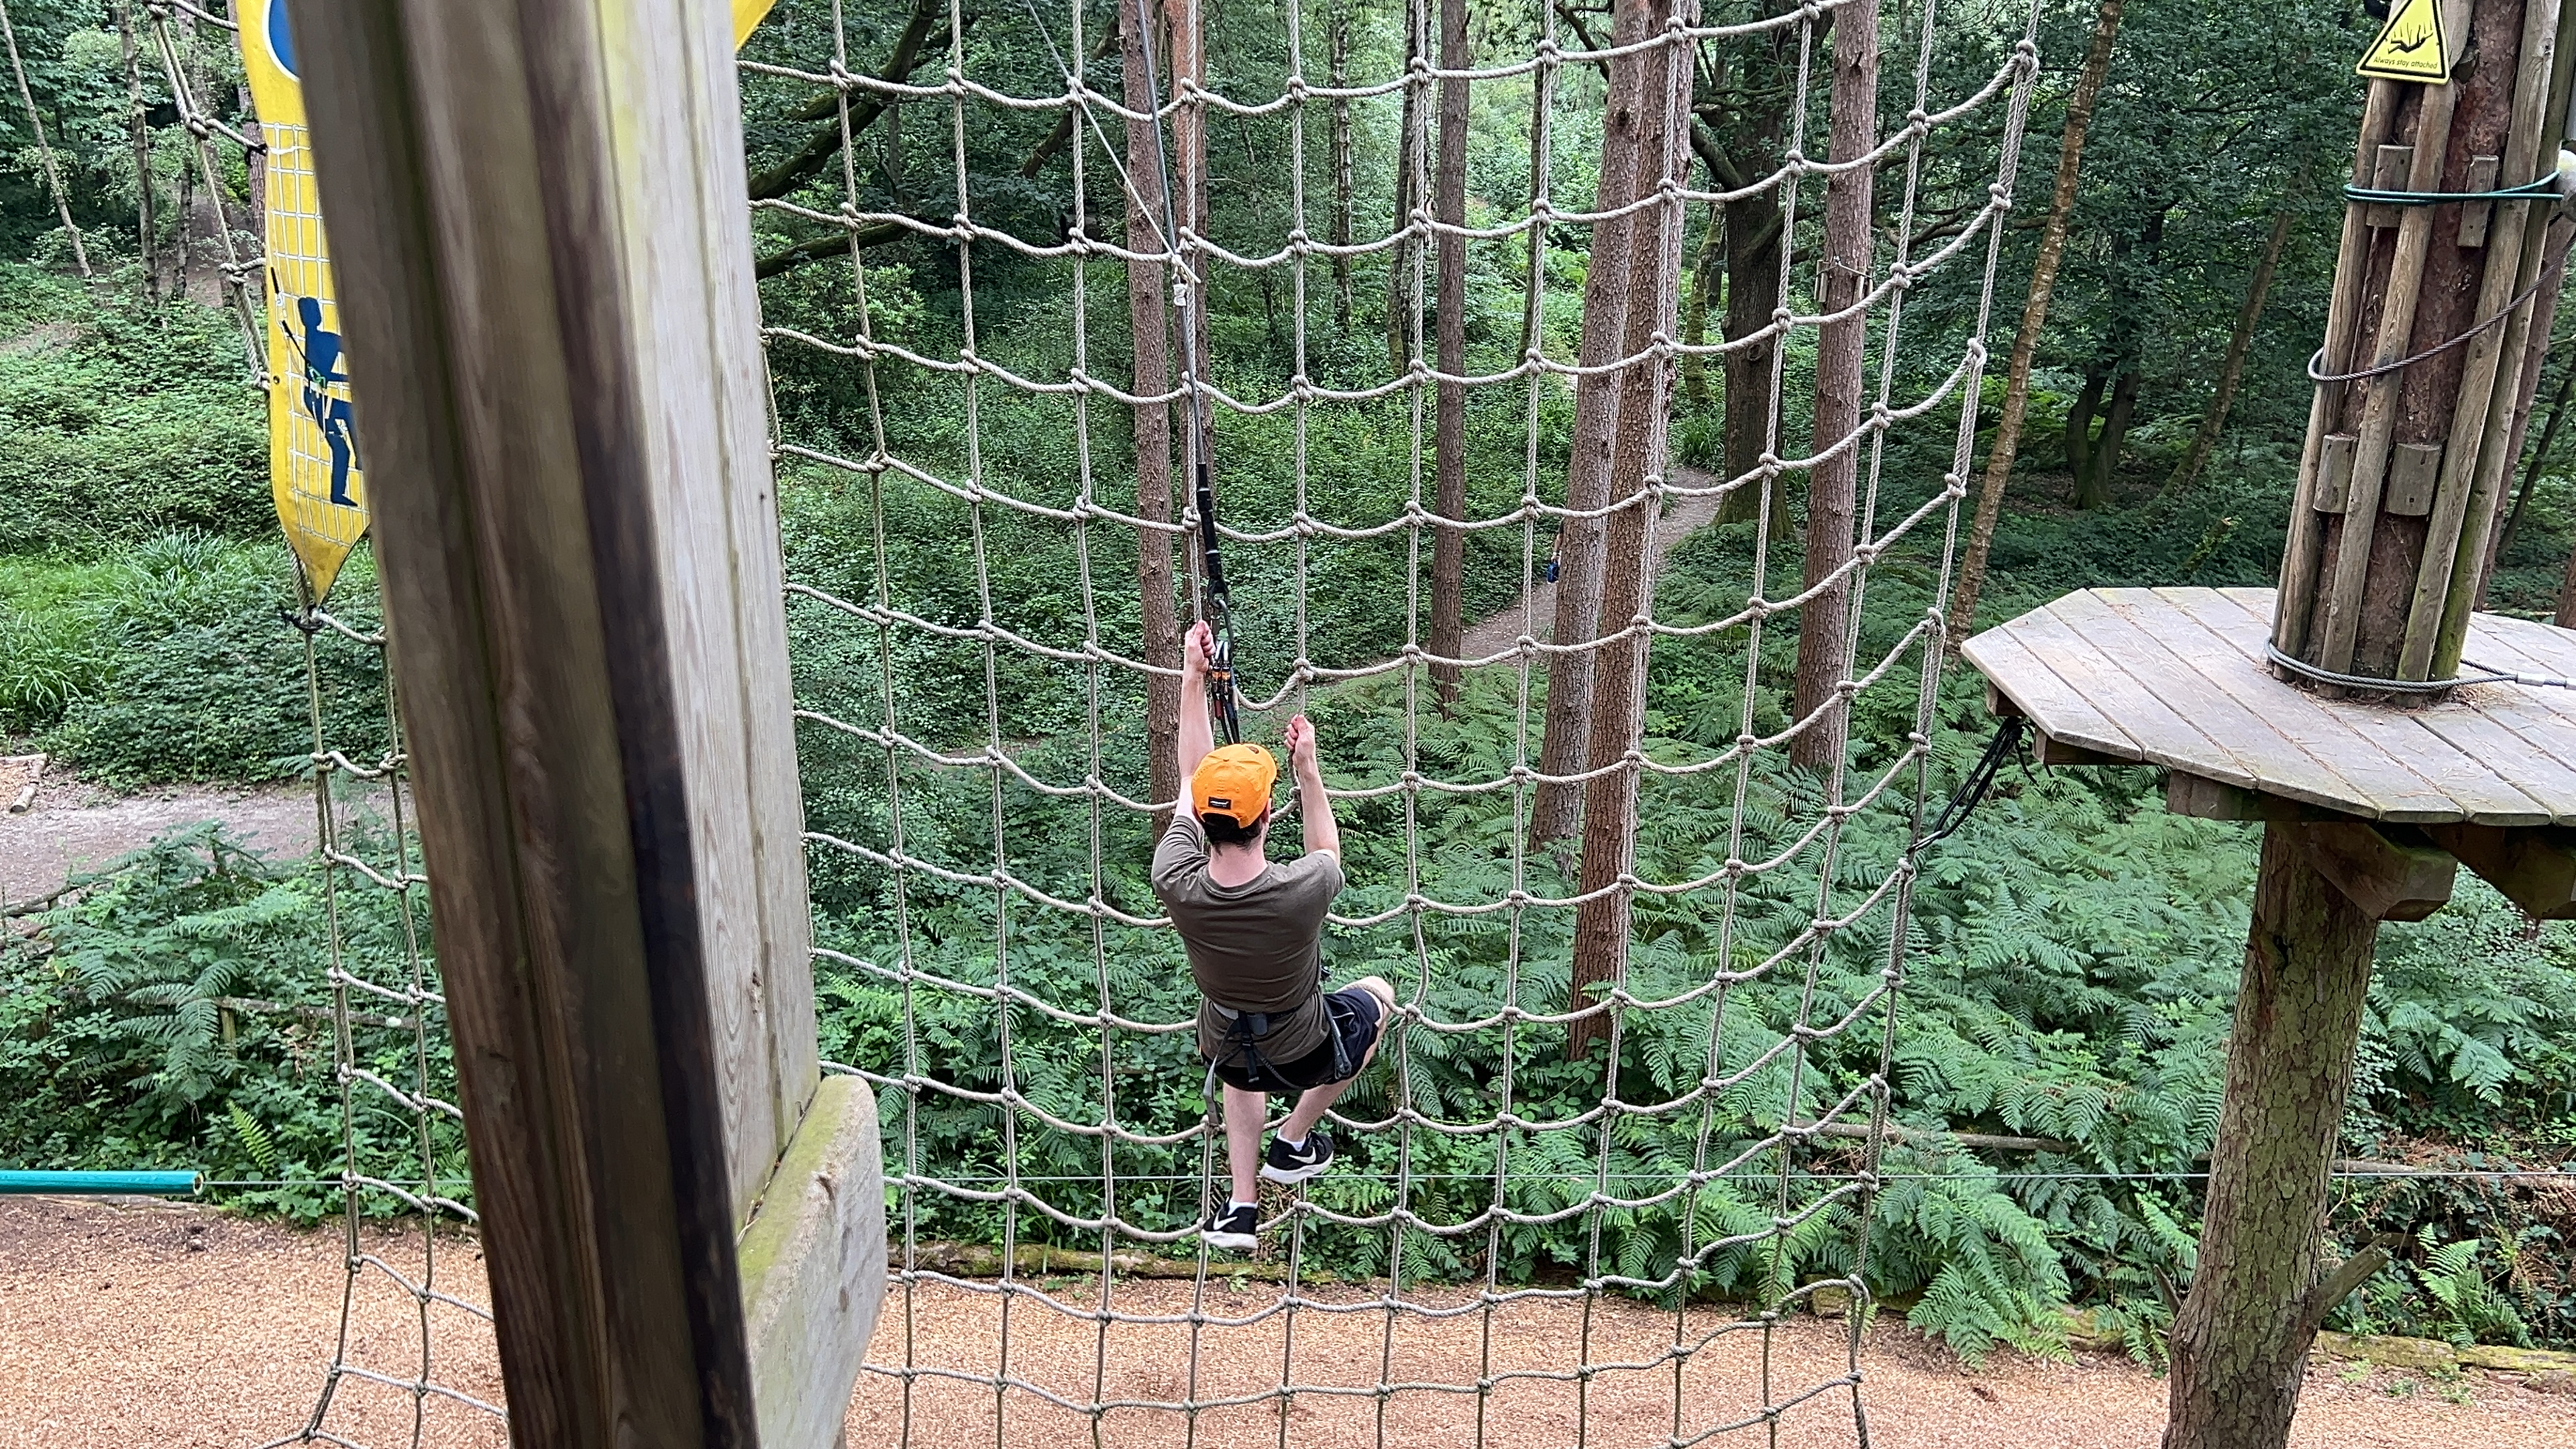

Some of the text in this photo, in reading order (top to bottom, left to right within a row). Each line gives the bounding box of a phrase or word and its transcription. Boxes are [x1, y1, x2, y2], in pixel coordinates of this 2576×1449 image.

[2373, 56, 2438, 69] Always stay attached
